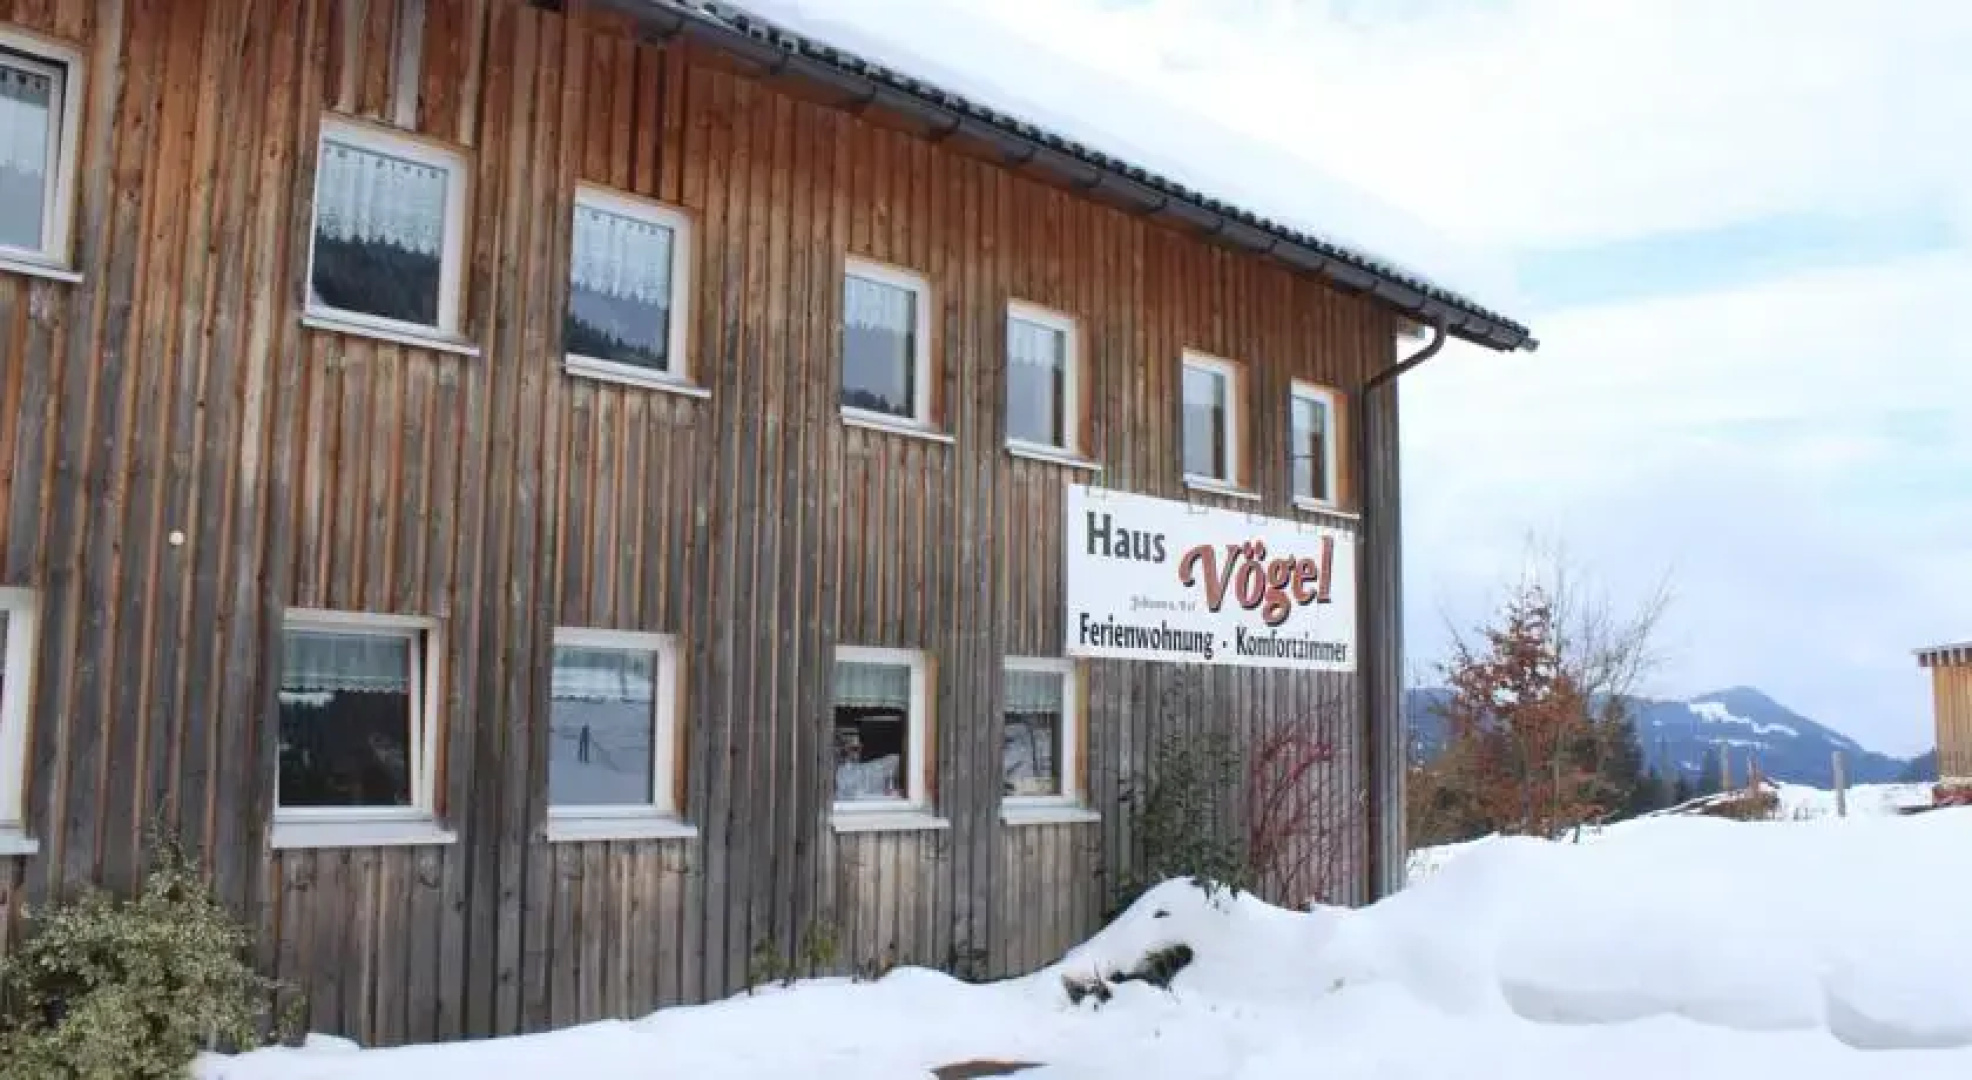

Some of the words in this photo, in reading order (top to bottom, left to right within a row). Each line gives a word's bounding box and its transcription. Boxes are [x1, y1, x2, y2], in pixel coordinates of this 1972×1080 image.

[1086, 511, 1165, 563] Haus
[1178, 535, 1334, 627] Vögel
[1079, 612, 1215, 660] Ferienwohnung
[1235, 625, 1348, 662] Komfortzimmer
